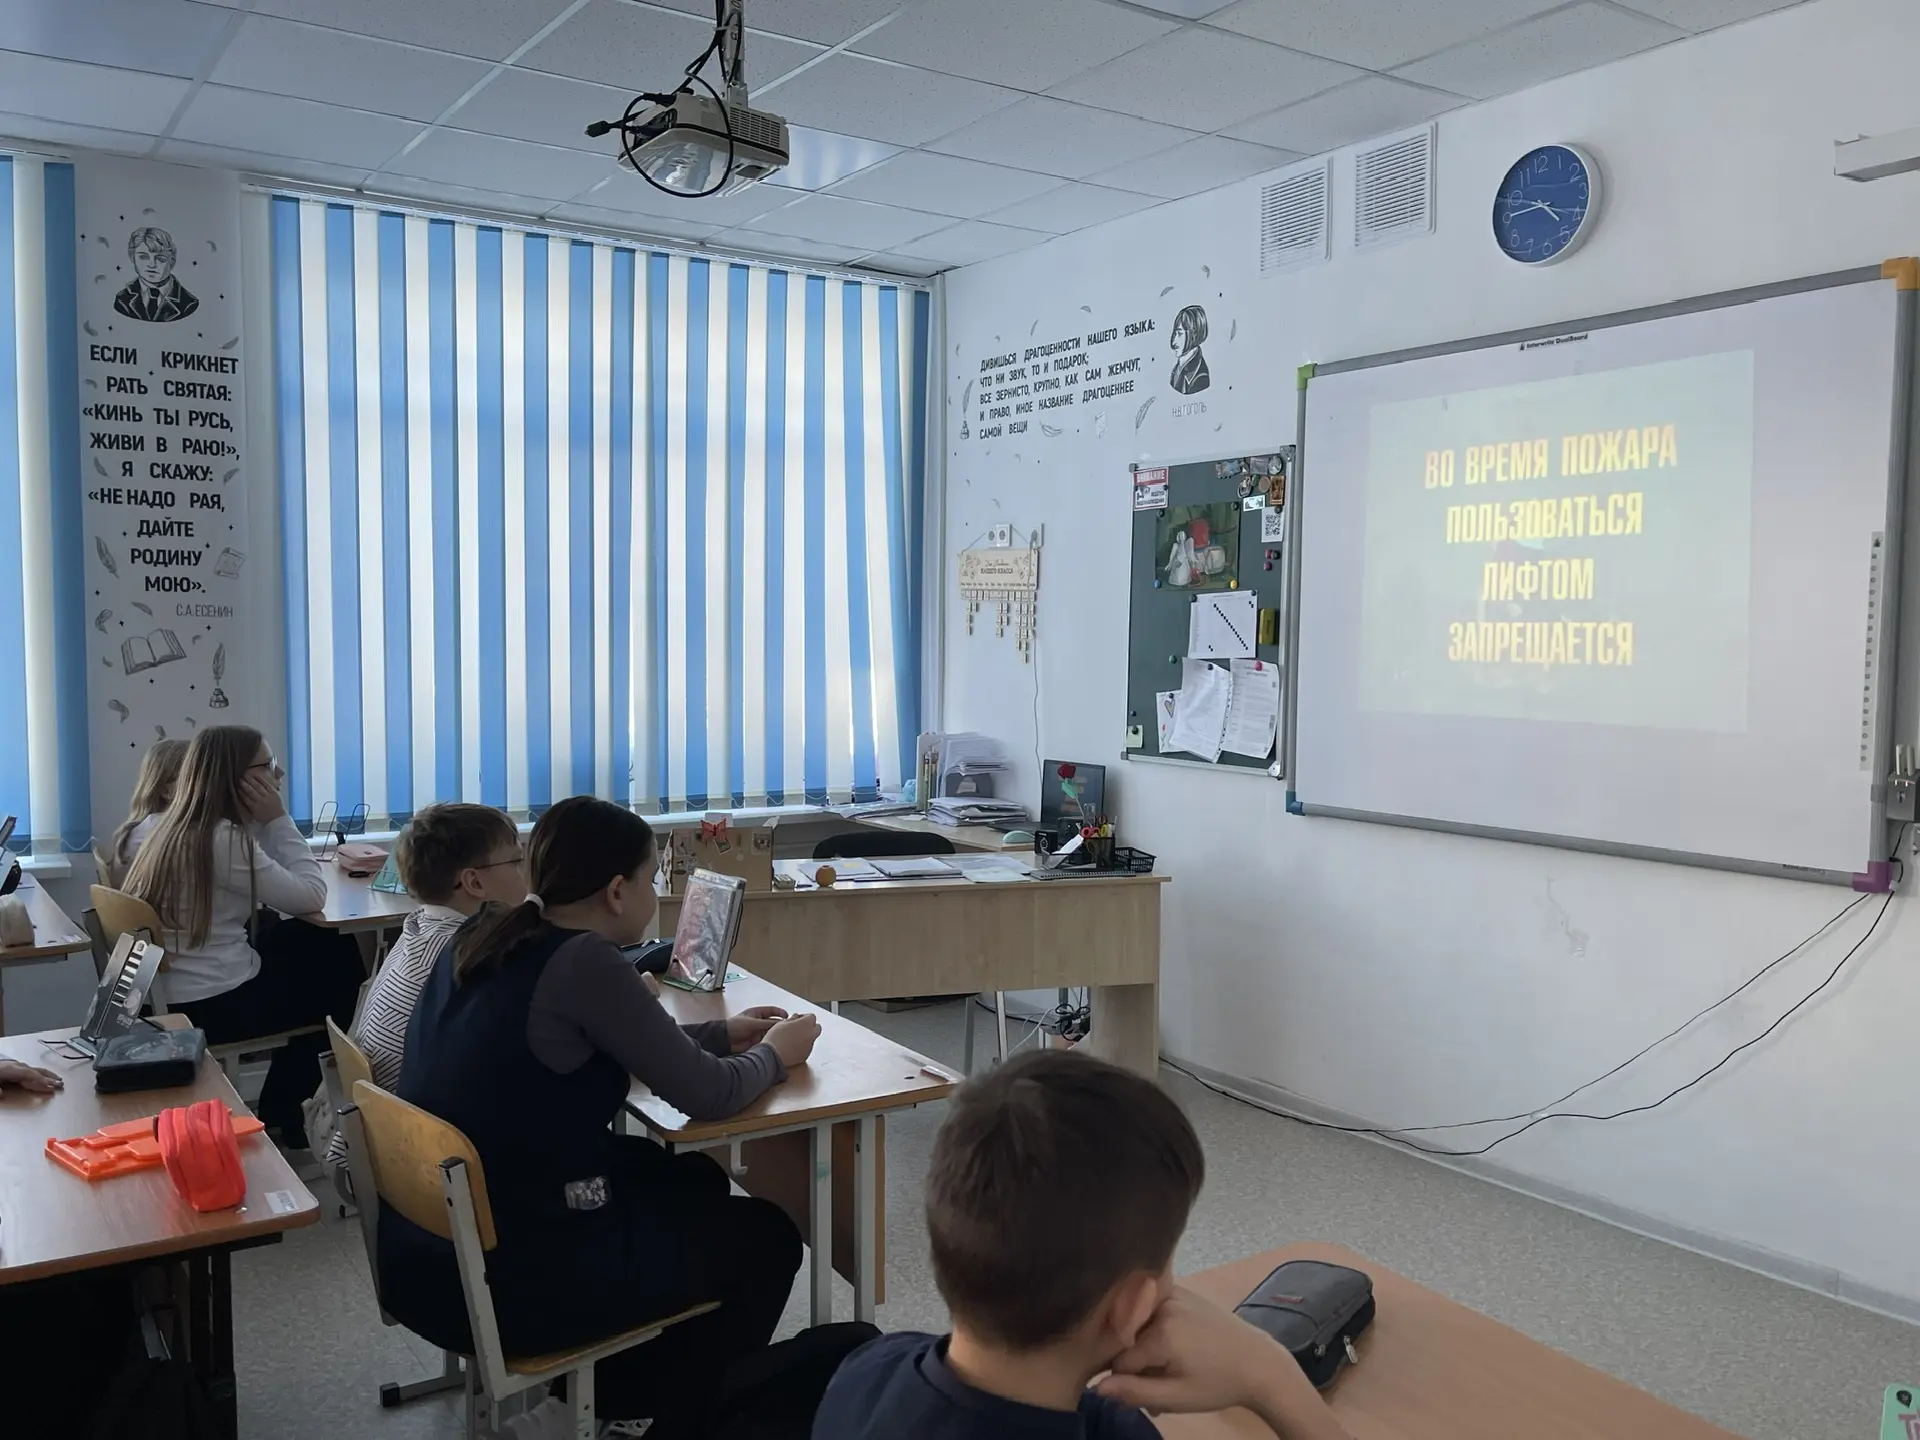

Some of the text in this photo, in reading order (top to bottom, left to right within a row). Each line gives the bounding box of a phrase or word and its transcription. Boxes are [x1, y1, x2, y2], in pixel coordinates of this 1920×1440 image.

[1534, 155, 1548, 174] 12
[1569, 163, 1580, 183] 2
[1518, 168, 1530, 188] 11
[1504, 190, 1523, 208] 10
[1578, 182, 1588, 199] 3
[1502, 212, 1512, 227] 9
[1572, 206, 1581, 221] 4
[1510, 229, 1520, 247] 8
[1560, 225, 1571, 244] 5
[1526, 238, 1534, 256] 7
[1542, 238, 1552, 255] 6
[980, 319, 1155, 373] ДИВИШЬСЯ ДРАГОЦЕННОСТИ НАШЕГО ЯЗЫКА:
[90, 344, 239, 374] ЕСЛИ КРИКНЕТ
[980, 352, 1089, 388] ЧТО НИ ЗВУК, ТО И ПОДАРОК;
[106, 376, 232, 402] РАТЬ СВЯТАЯ:
[980, 357, 1141, 405] ВСЕ ЗЕРНИСТО, КРУПНО, КАК САМ ЖЕМЧУГ,
[980, 380, 1134, 421] И ПРАВО, ИНОЕ НАЗВАНИЕ ДРАГОЦЕННЕЕ
[82, 403, 234, 433] «КИНЬ ТЫ РУСЬ,
[980, 420, 1028, 439] САМОЙ ВЕЩИ
[90, 432, 240, 461] ЖИВИ В РАЮ!»,
[1424, 422, 1678, 490] ВО ВРЕМЯ ПОЖАРА
[121, 460, 214, 482] Я СКАЖУ:
[87, 487, 225, 513] «НЕ НАДО РАЯ,
[136, 516, 195, 538] ДАЙТЕ
[1445, 491, 1644, 544] ПОЛЬЗОВАТЬСЯ
[130, 547, 203, 568] РОДИНУ
[144, 575, 206, 594] МОЮ».
[1481, 558, 1595, 601] ЛИФТОМ
[1447, 621, 1635, 670] ЗАПРЕЩАЕТСЯ
